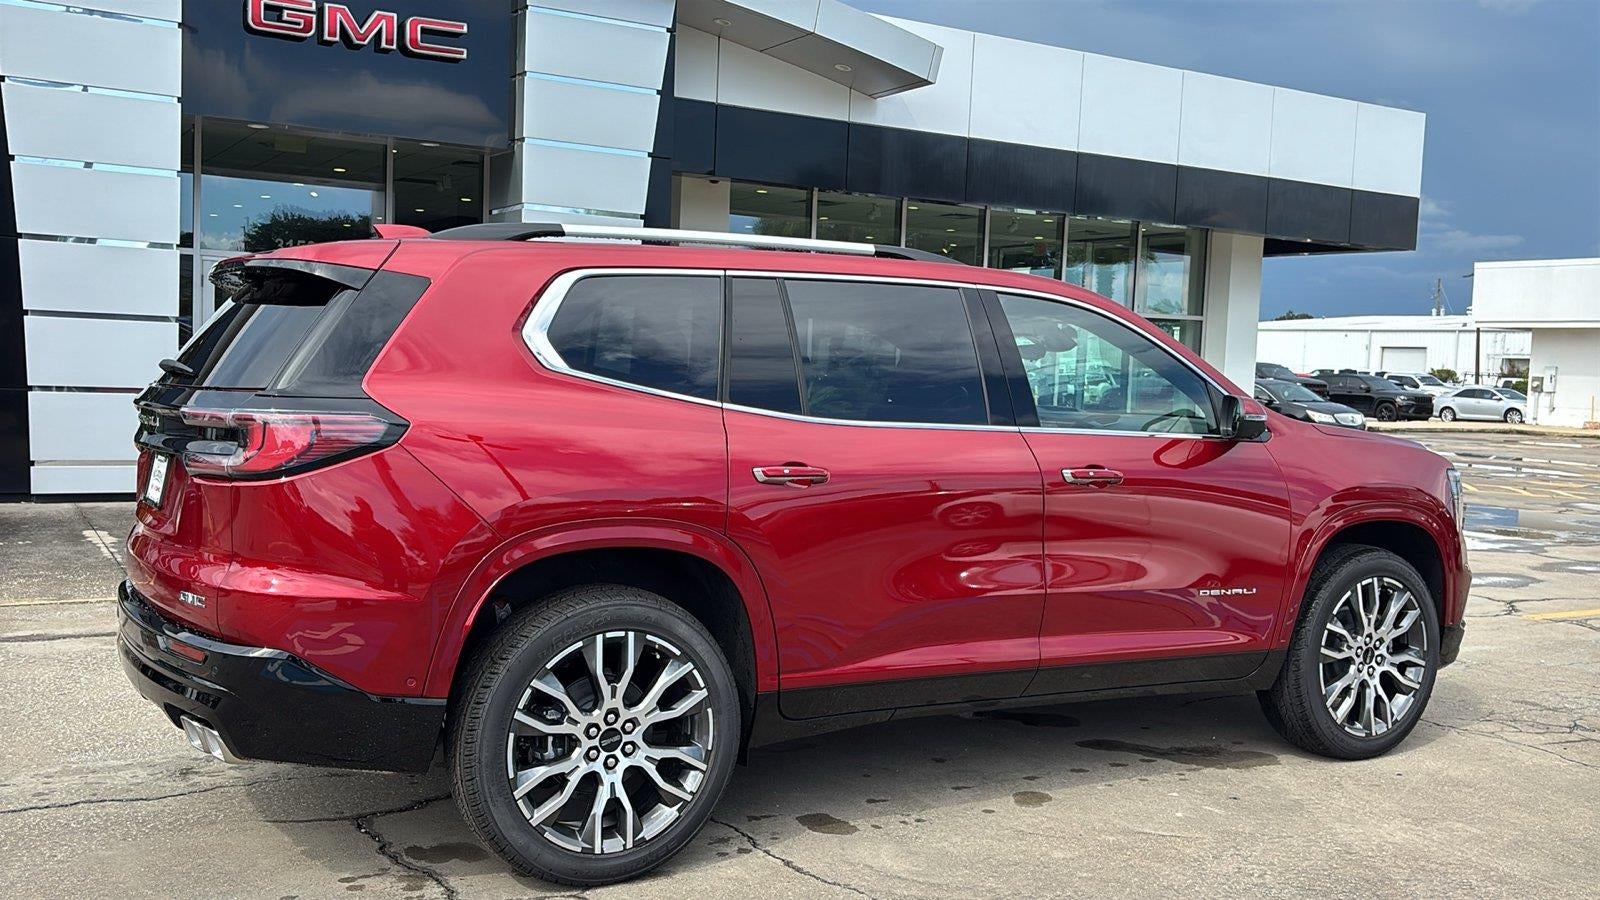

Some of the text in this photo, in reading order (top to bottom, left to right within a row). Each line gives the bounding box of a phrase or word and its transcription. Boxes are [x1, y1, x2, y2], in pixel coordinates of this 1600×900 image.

[246, 0, 468, 60] GMC
[180, 590, 206, 608] GMC
[1199, 588, 1257, 596] DENALI
